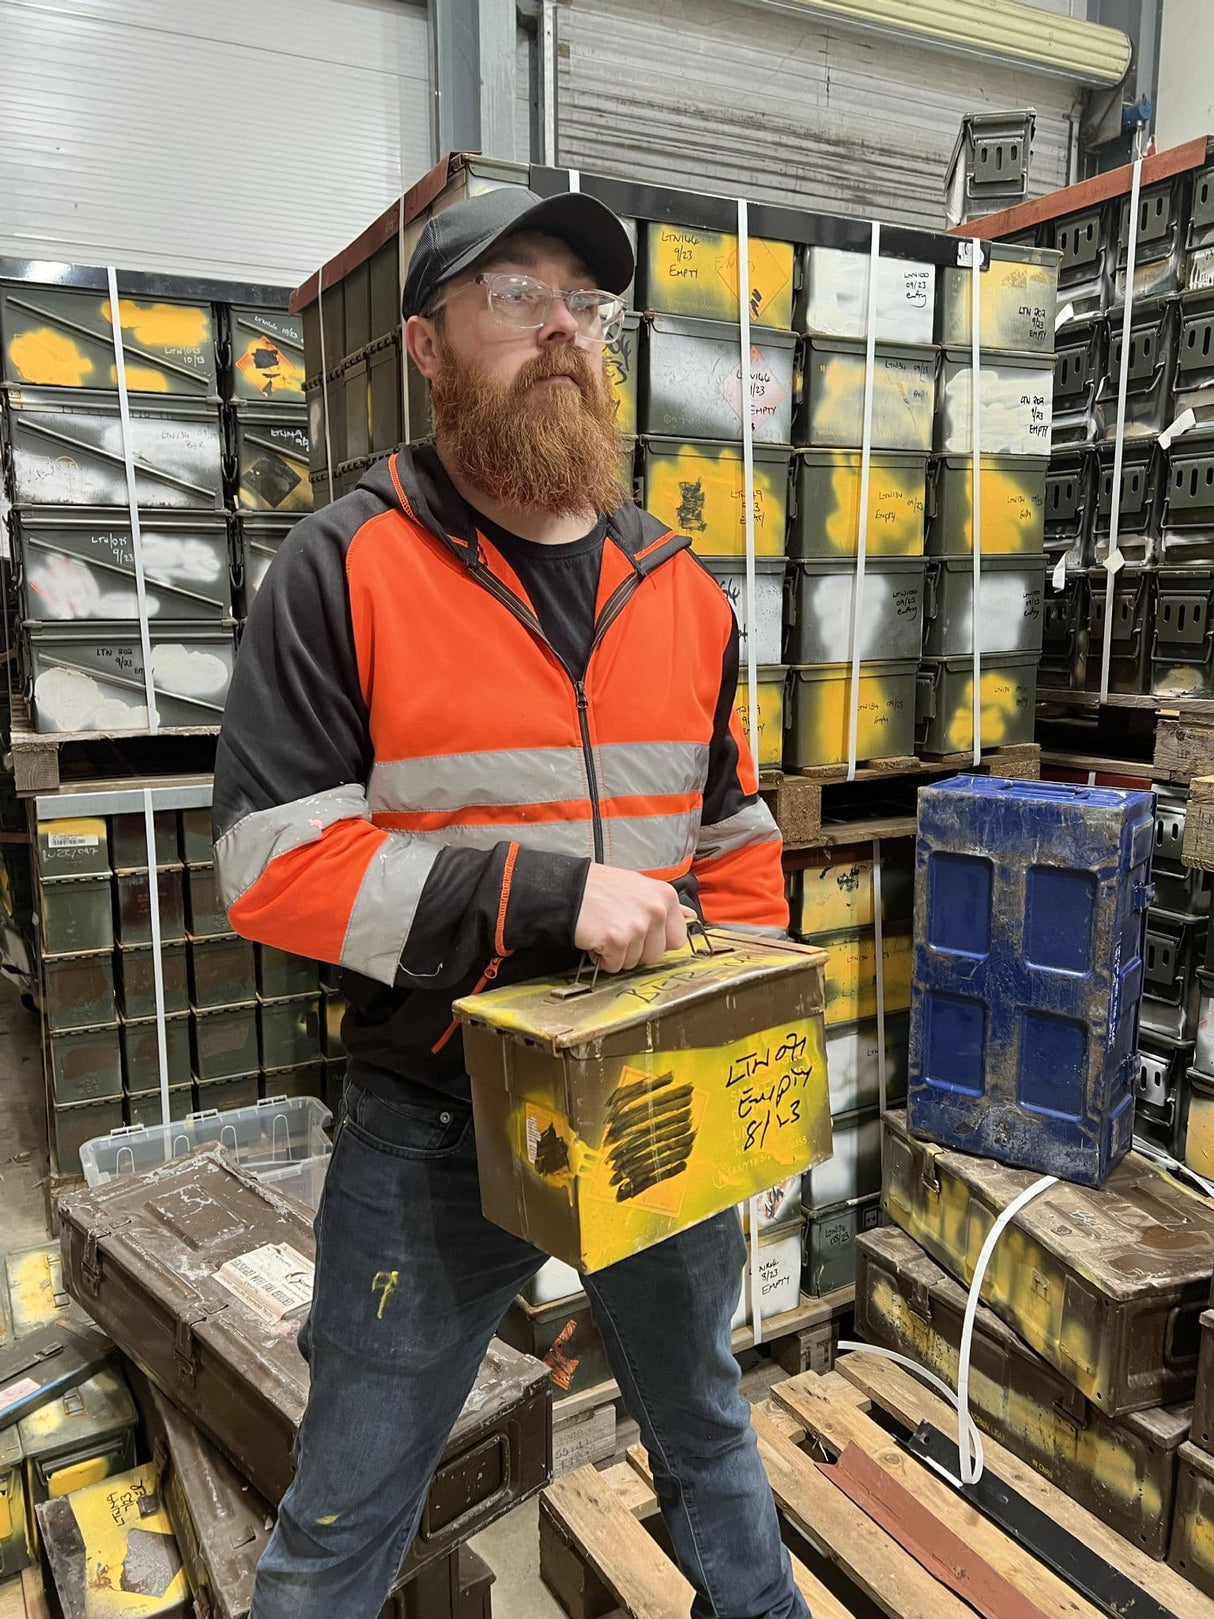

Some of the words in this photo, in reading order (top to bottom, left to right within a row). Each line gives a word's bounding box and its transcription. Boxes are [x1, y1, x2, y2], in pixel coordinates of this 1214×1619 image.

[674, 246, 693, 262] 9/23
[669, 264, 699, 279] EMPTY
[905, 281, 927, 290] 09/23
[96, 647, 113, 657] LTN
[761, 1275, 790, 1295] EMPTY
